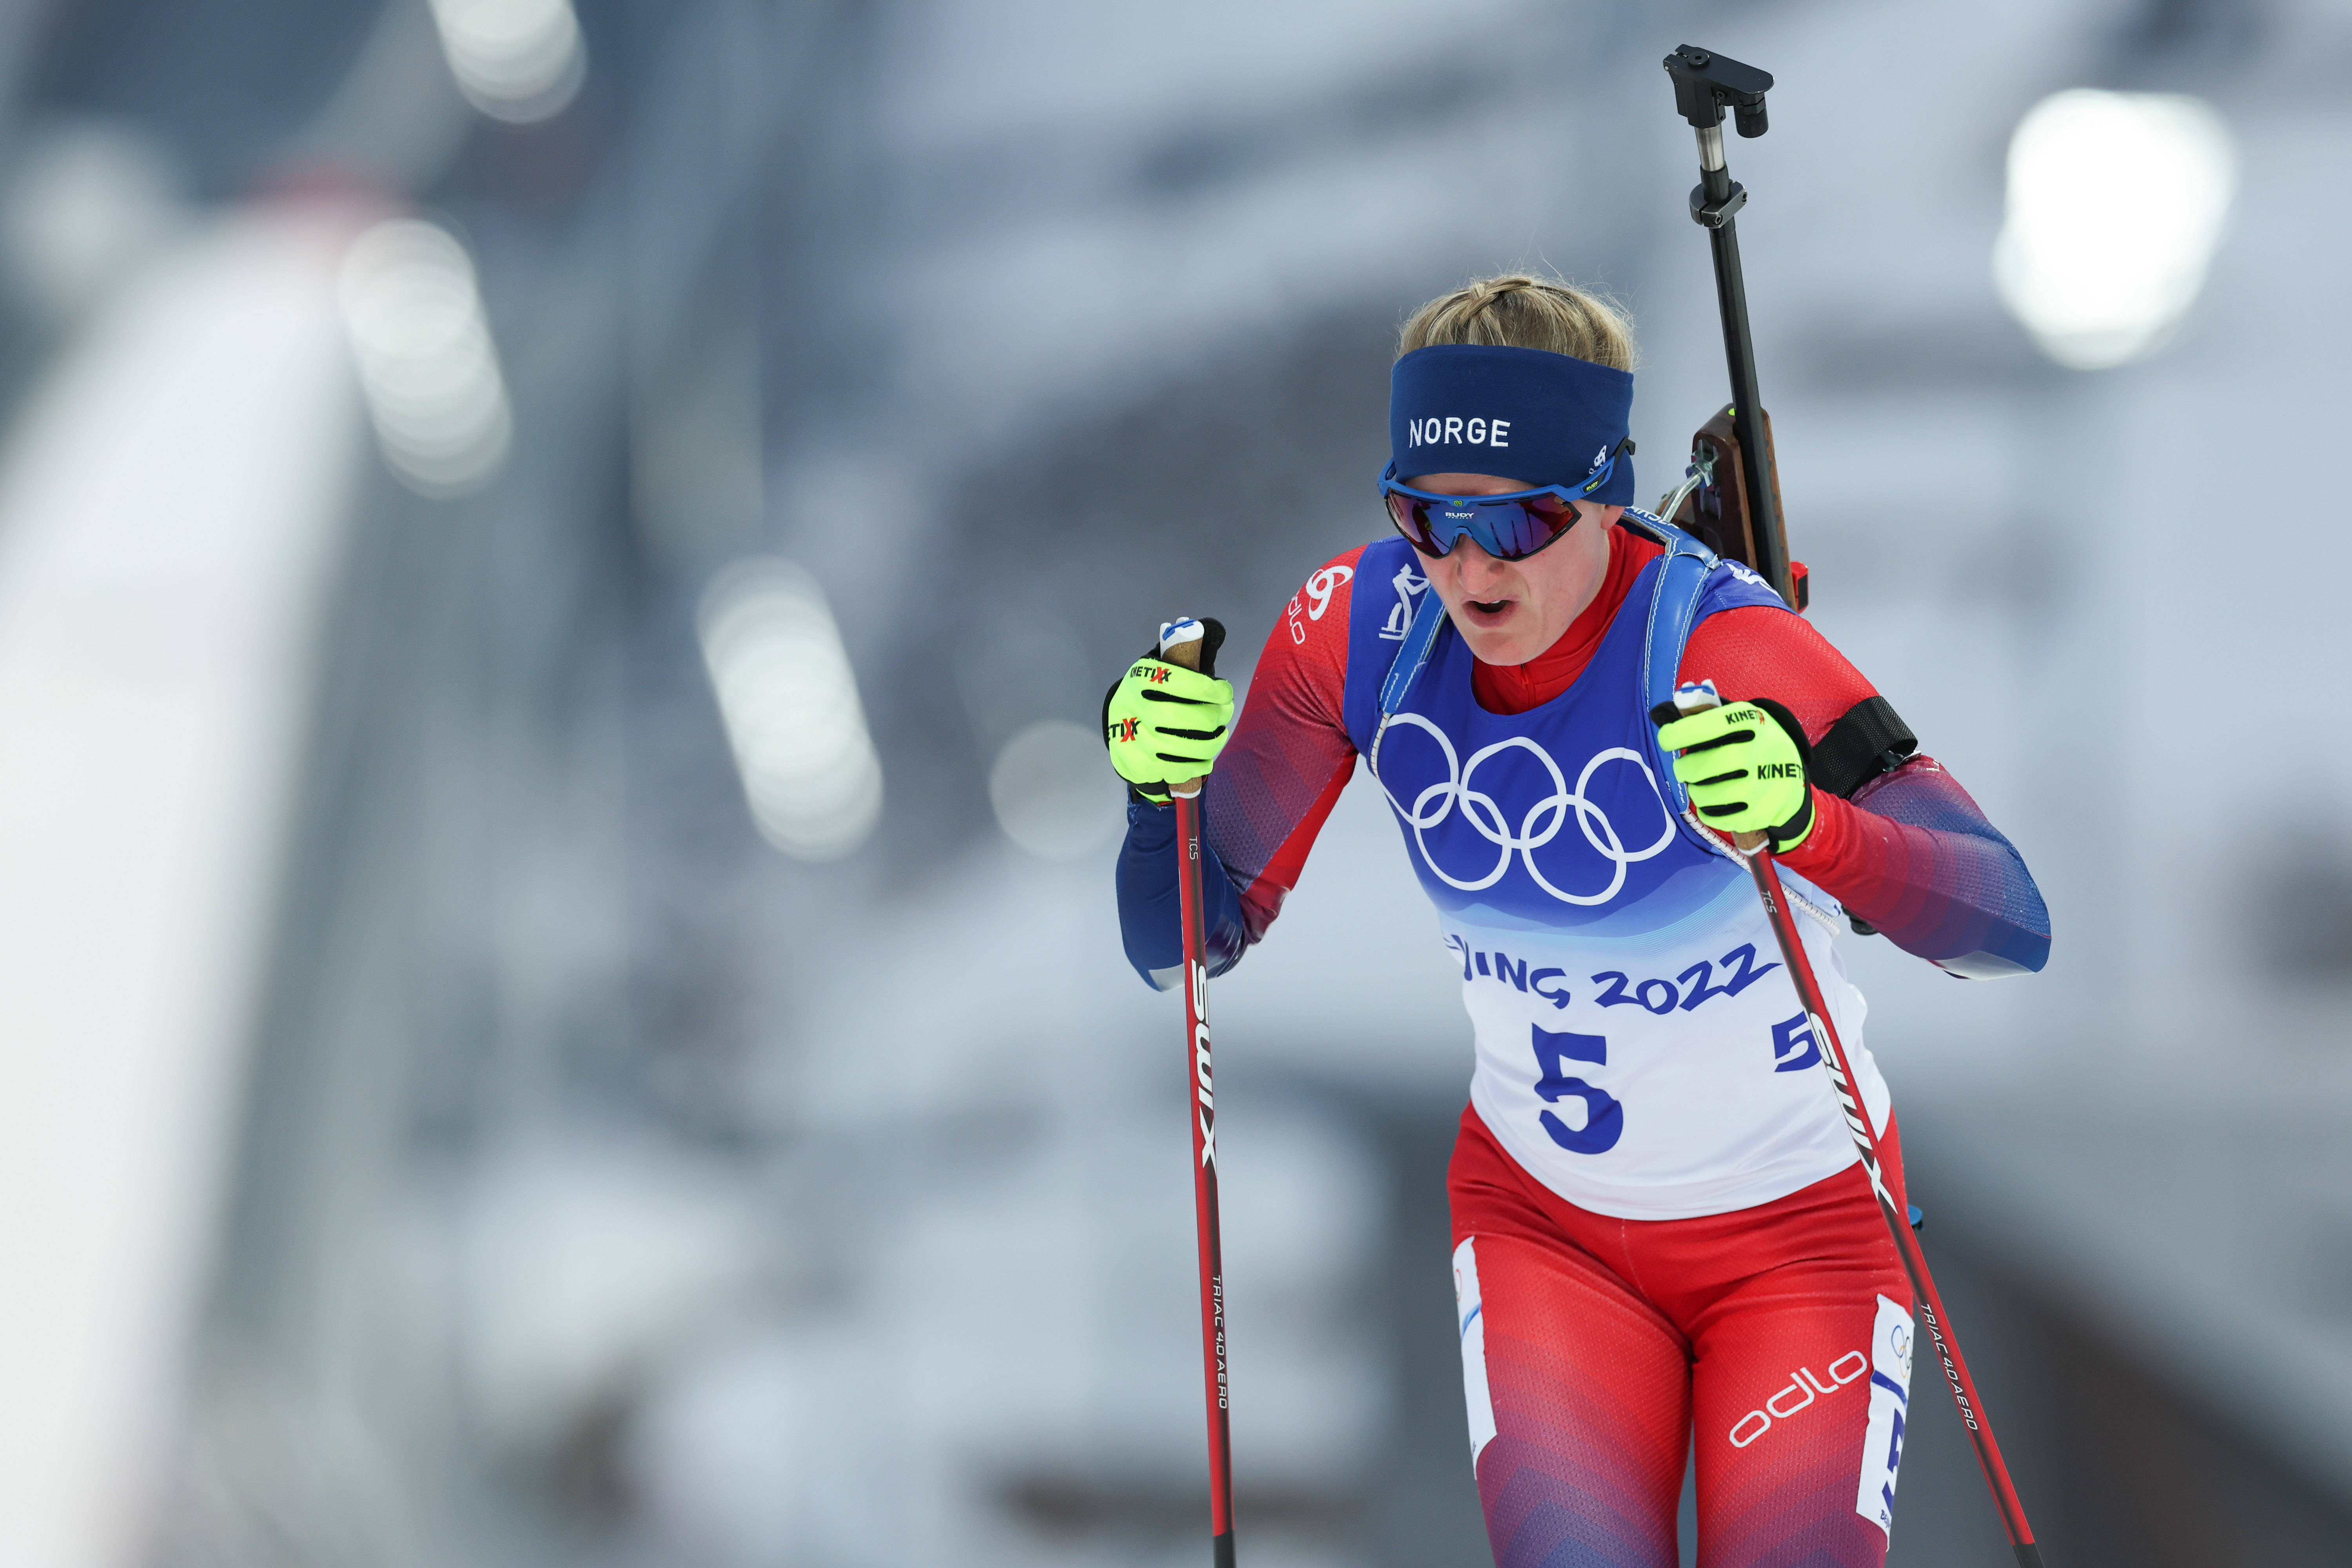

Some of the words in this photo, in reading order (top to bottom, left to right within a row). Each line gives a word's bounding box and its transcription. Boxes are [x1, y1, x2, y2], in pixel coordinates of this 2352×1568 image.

[1409, 417, 1511, 448] NORGE
[1586, 481, 1598, 491] RUDY
[1591, 942, 1783, 1015] 2022
[1191, 958, 1217, 1178] SWIX
[1771, 1011, 1822, 1073] 5
[1532, 1022, 1624, 1155] 5
[1804, 1006, 1898, 1215] SWIX
[1212, 1274, 1223, 1327] TRIAC
[1216, 1331, 1225, 1356] 4.0
[1921, 1303, 1948, 1354] TRIAC
[1943, 1357, 1958, 1381] 4.0
[1951, 1381, 1978, 1430] AERO
[1217, 1358, 1227, 1409] AERO
[1729, 1350, 1867, 1448] odlo
